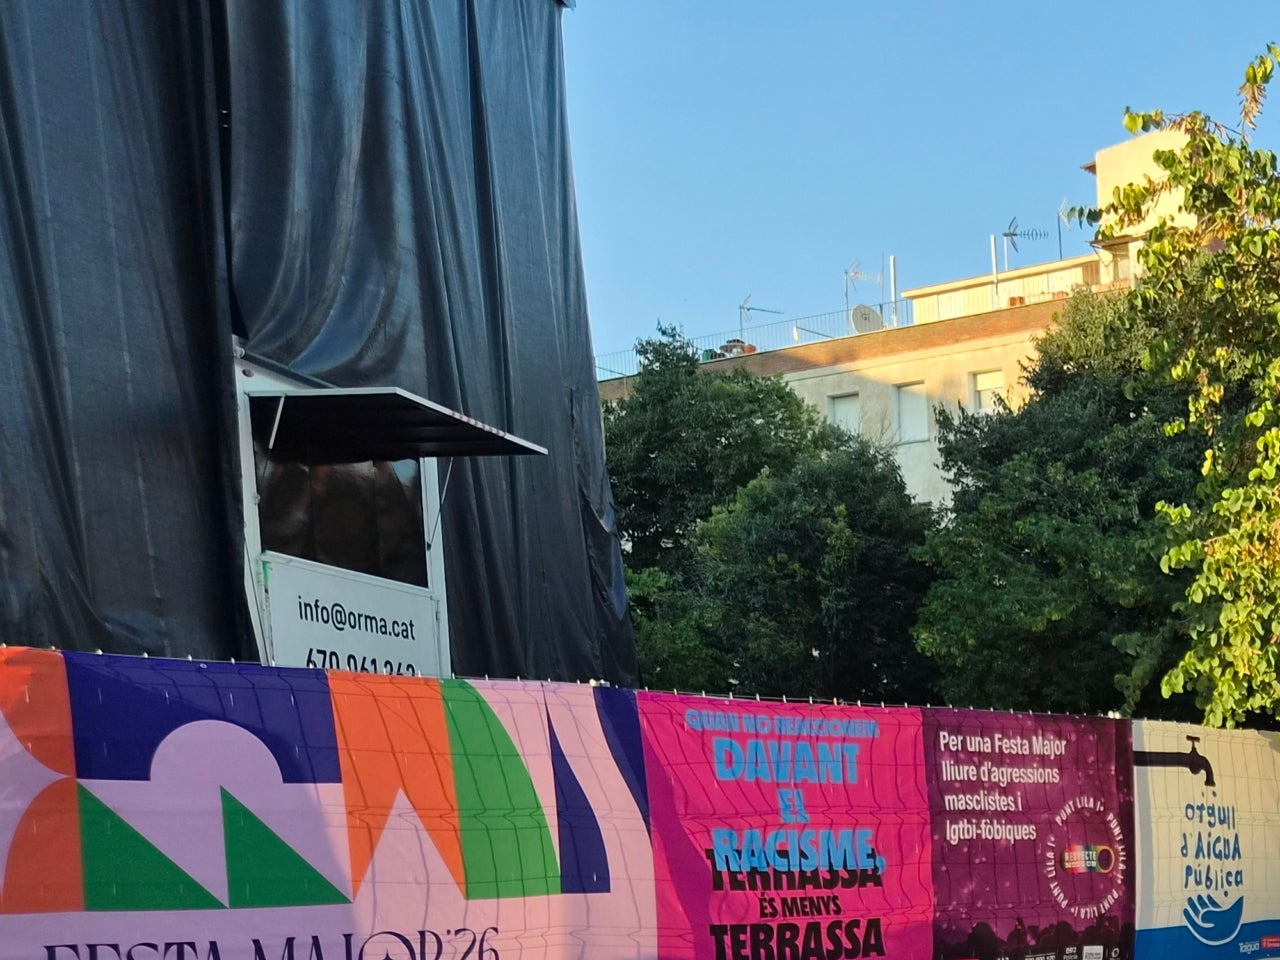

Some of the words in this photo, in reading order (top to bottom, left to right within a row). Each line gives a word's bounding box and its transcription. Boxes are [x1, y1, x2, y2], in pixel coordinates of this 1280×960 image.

[299, 595, 415, 640] info@orma.cat
[685, 709, 739, 732] QUAN
[743, 714, 771, 734] NO
[939, 731, 963, 751] Per
[966, 735, 991, 753] una
[994, 733, 1029, 755] Festa
[1032, 735, 1066, 760] Major
[712, 737, 860, 785] DAVANT
[942, 760, 977, 781] lliure
[980, 761, 1060, 787] d'agressions
[778, 788, 810, 823] EL
[944, 790, 1015, 811] masclistes
[1017, 791, 1022, 811] i
[1055, 801, 1076, 826] PUNT
[1076, 796, 1094, 808] LILA
[711, 828, 887, 875] RACISME,
[759, 892, 778, 918] ÉS
[781, 895, 842, 918] MENYS
